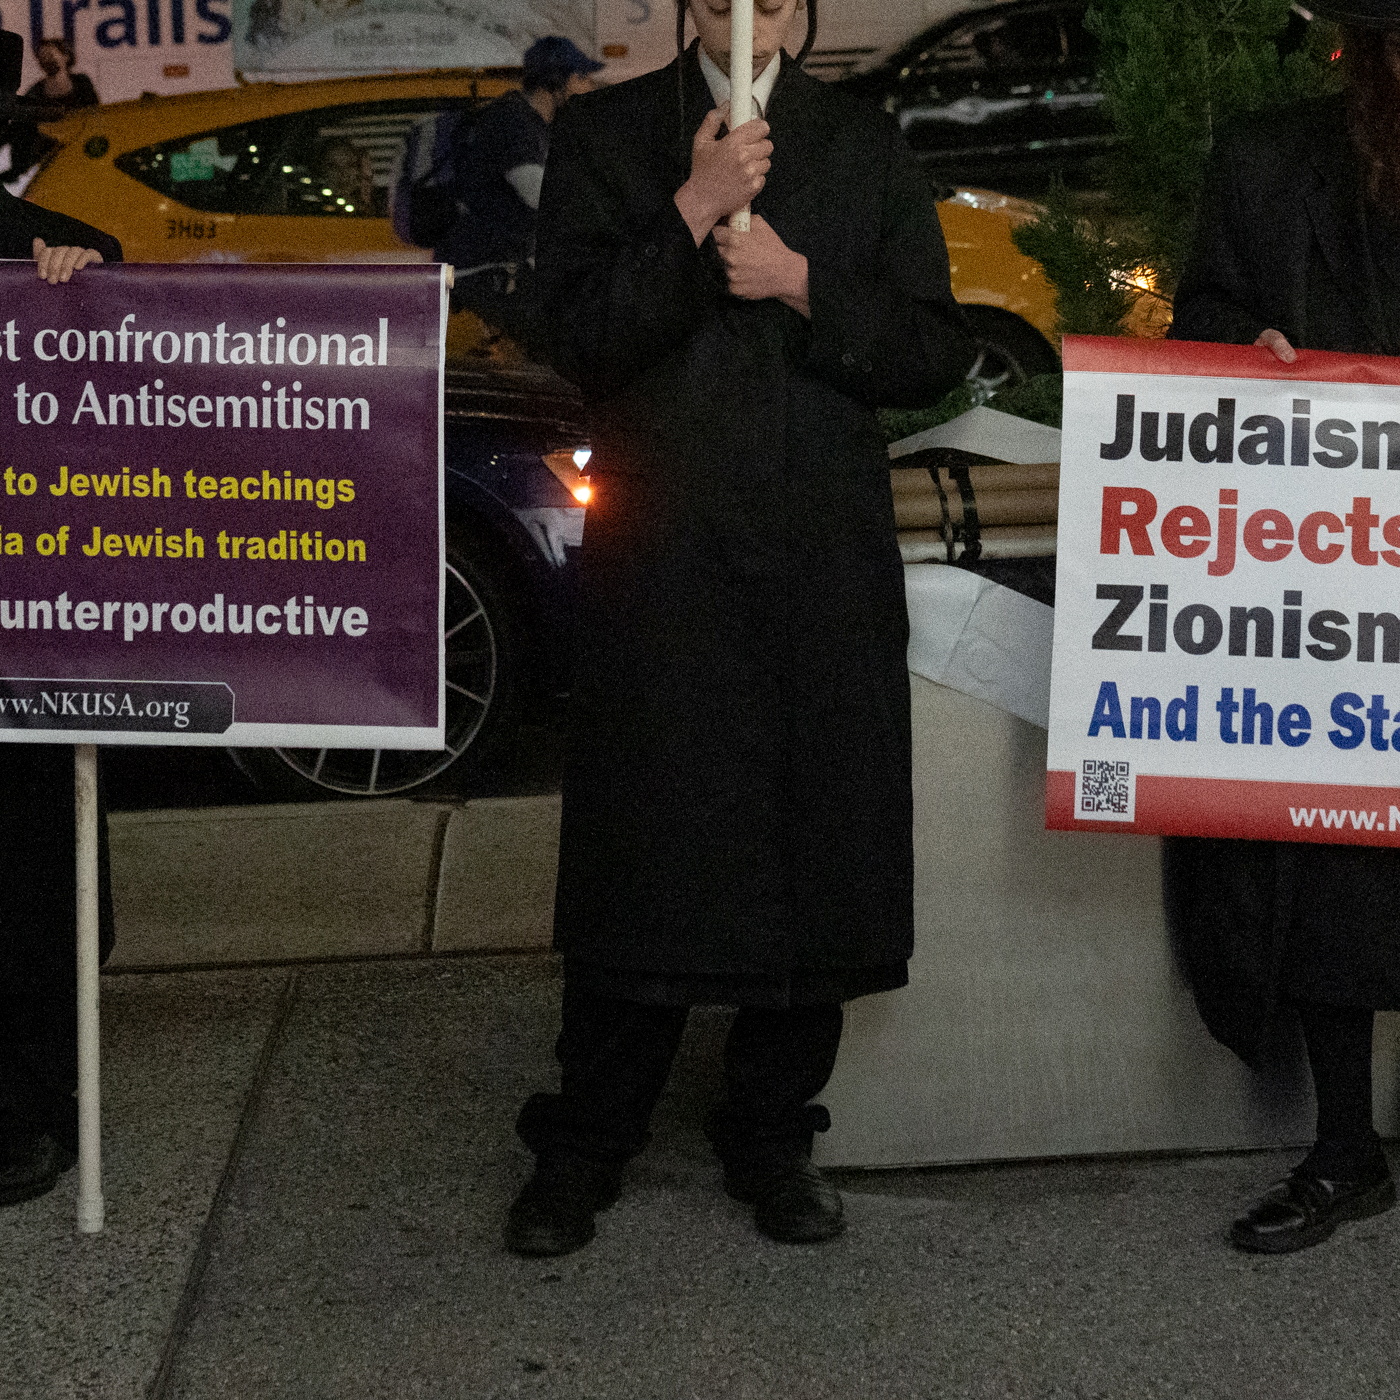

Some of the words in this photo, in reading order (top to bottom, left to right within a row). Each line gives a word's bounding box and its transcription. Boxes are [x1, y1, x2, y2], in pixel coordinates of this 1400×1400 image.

[34, 314, 389, 366] confrontational
[14, 385, 59, 426] to
[73, 379, 371, 430] Antisemitism
[4, 468, 37, 495] to
[49, 466, 172, 499] Jewish
[184, 470, 356, 510] teachings
[36, 526, 69, 556] of
[82, 528, 204, 559] Jewish
[217, 530, 366, 562] tradition
[1087, 681, 1198, 742] And
[1217, 688, 1310, 747] the
